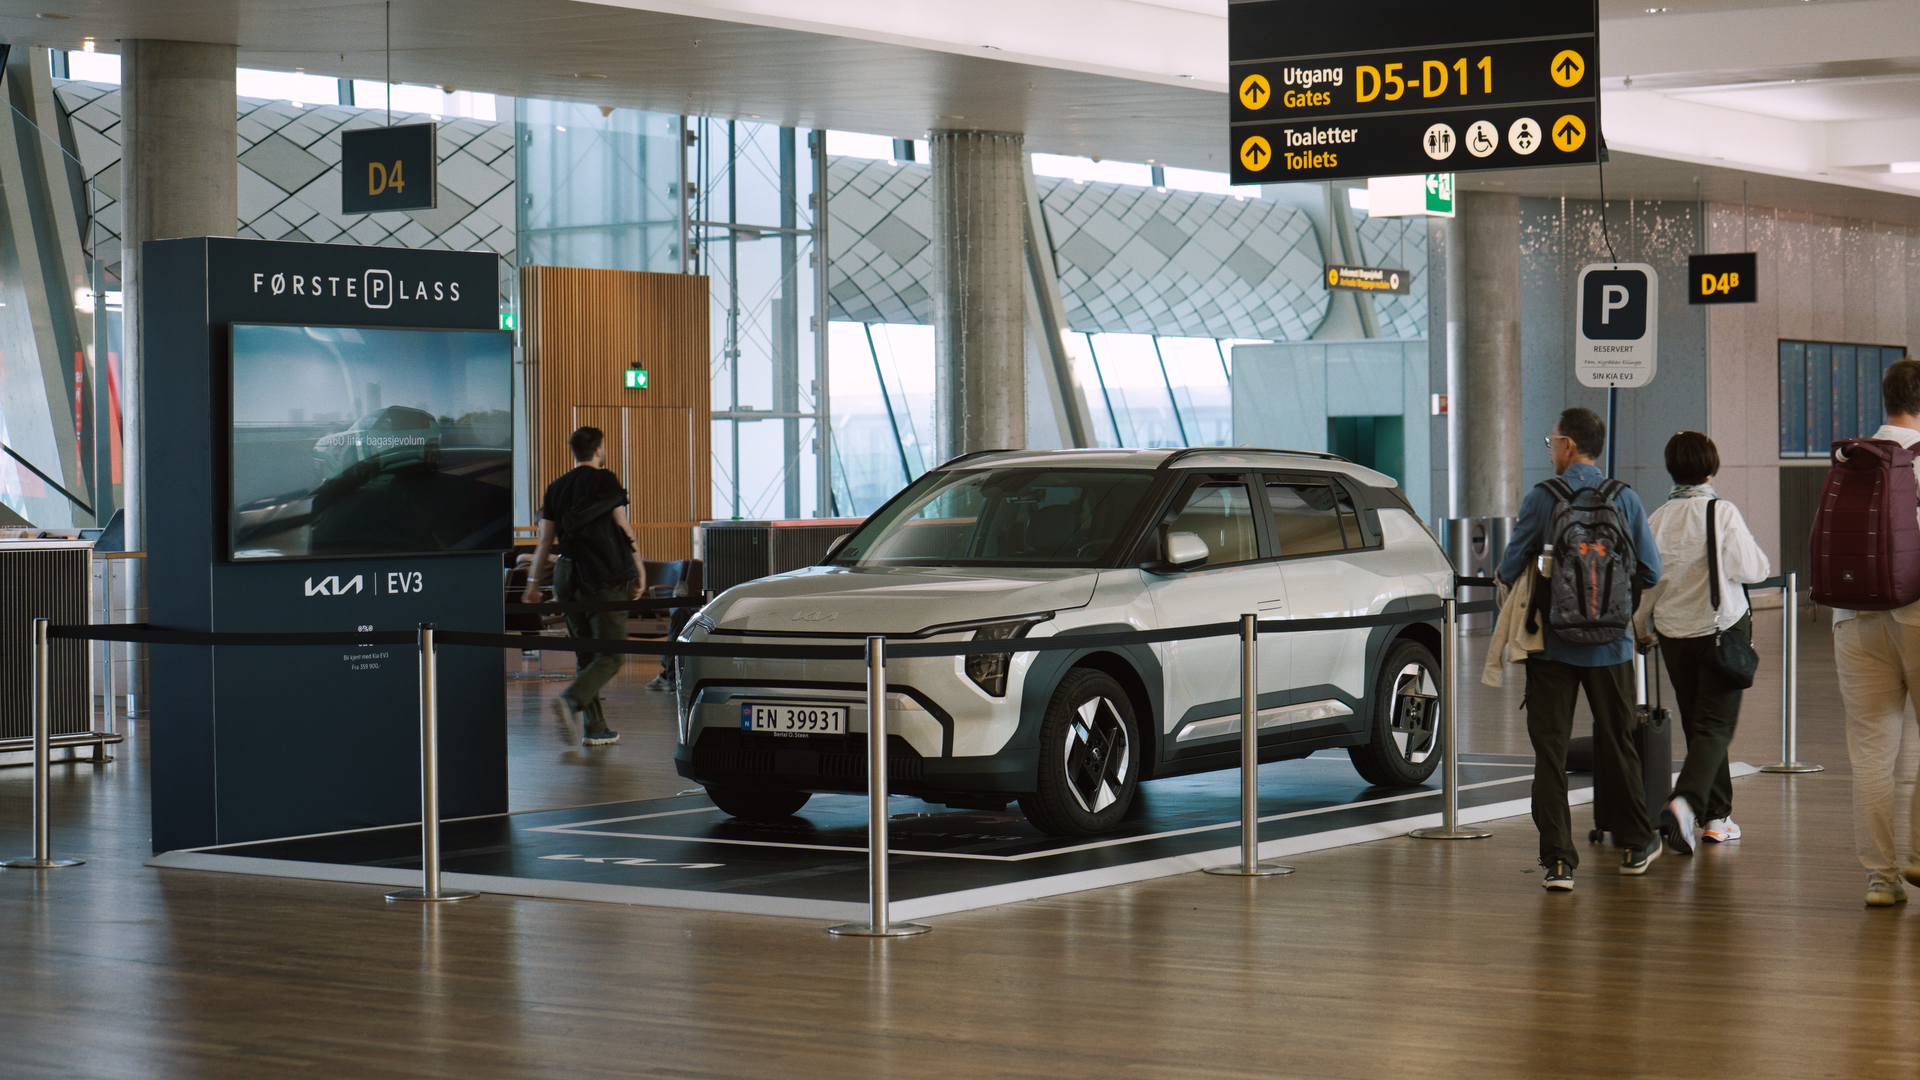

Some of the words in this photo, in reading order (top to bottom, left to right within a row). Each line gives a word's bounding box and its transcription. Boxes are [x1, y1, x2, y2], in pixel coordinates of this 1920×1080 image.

[1283, 67, 1344, 89] Utgang
[1356, 55, 1493, 104] D5-D11
[1283, 90, 1332, 109] Gates
[1283, 126, 1359, 148] Toaletter
[1284, 150, 1339, 170] Toilets
[368, 160, 405, 196] D4
[1601, 284, 1630, 325] P
[1593, 345, 1634, 353] RESERVERT
[366, 434, 425, 449] bagasjevolum
[304, 574, 364, 597] KIA
[387, 571, 424, 594] EV3
[756, 708, 778, 729] EN
[786, 709, 839, 731] 39931
